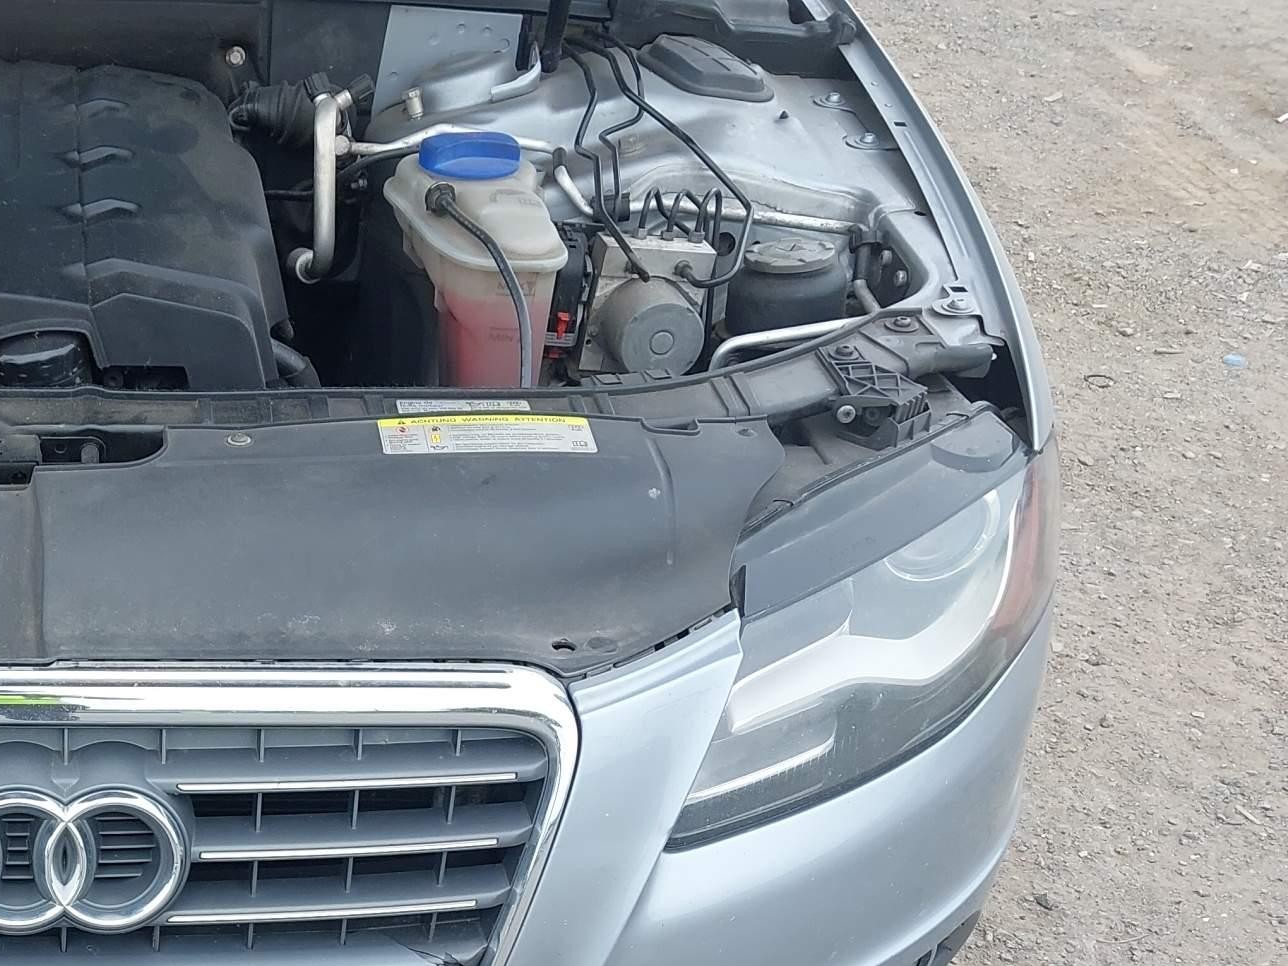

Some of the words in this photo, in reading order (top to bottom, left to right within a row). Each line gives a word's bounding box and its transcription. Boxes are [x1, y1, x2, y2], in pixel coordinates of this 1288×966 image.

[410, 417, 457, 425] ACHTUNG
[461, 416, 509, 424] WARNING
[514, 416, 567, 424] ATTENTION
